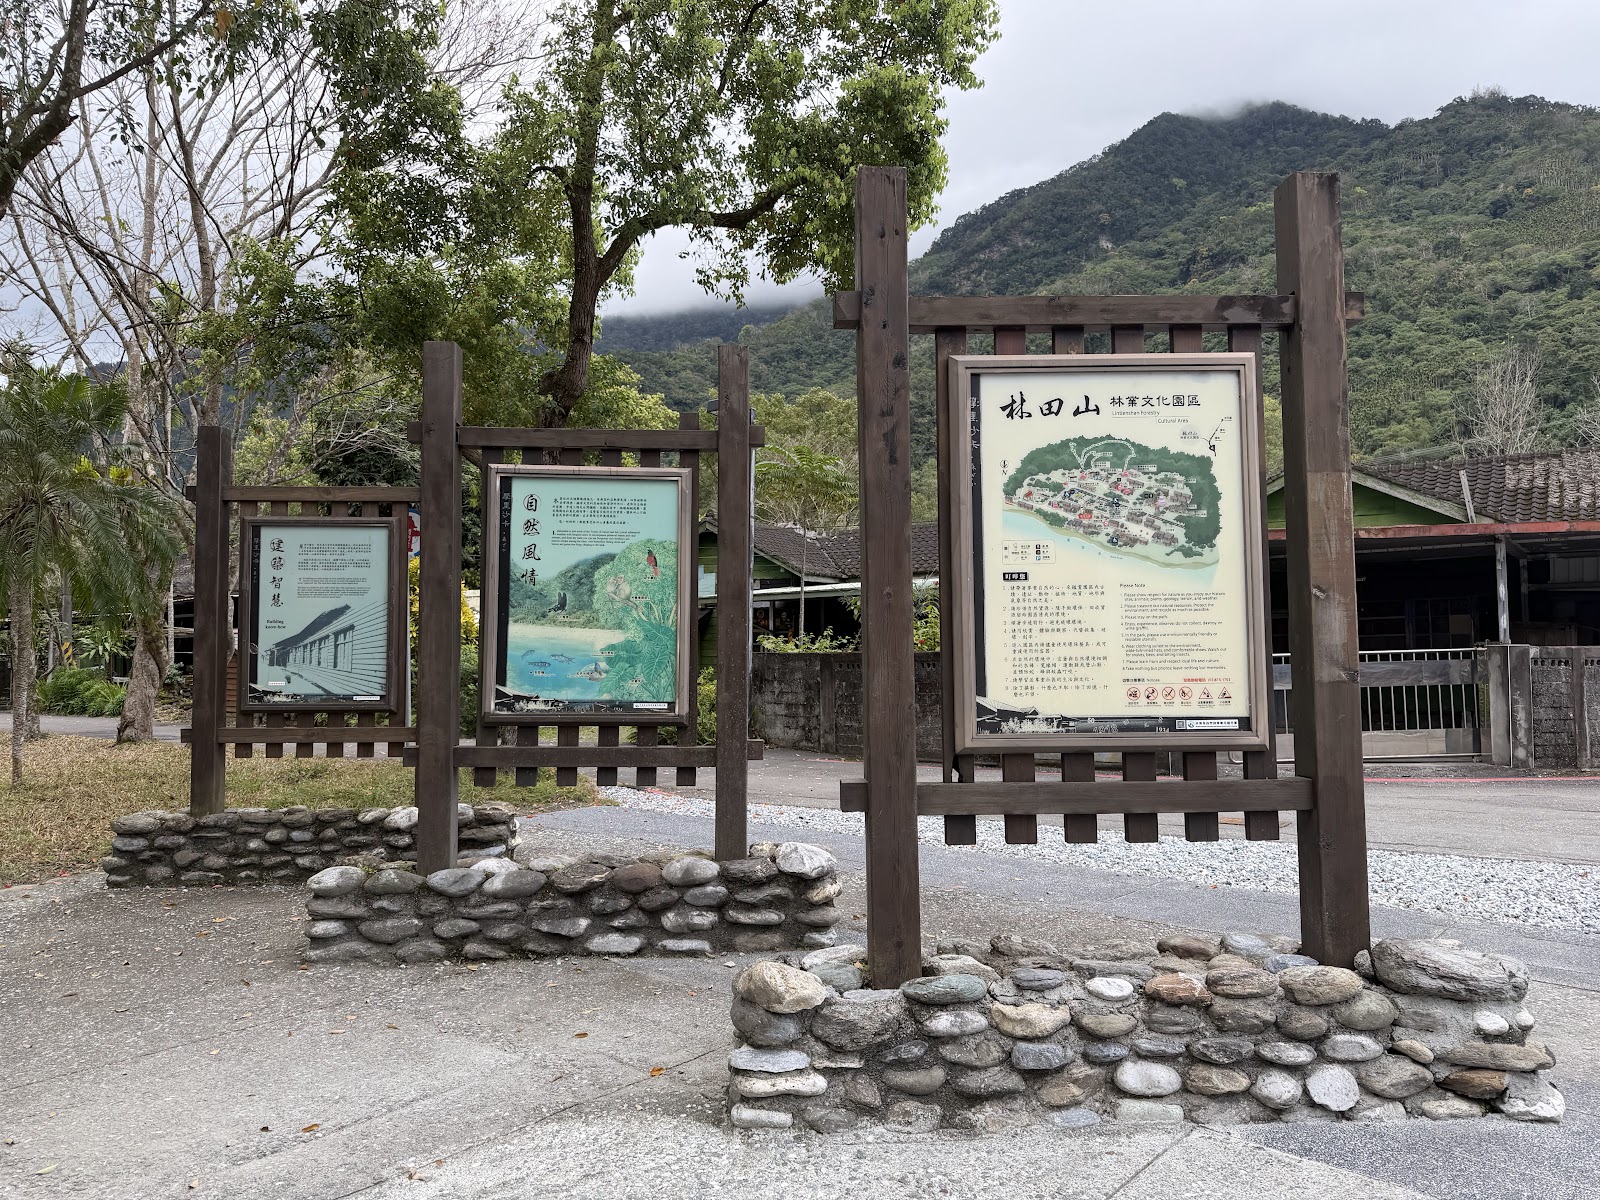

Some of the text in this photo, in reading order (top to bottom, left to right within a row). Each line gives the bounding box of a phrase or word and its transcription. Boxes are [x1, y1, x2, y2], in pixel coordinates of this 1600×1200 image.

[999, 391, 1100, 420] 林田山
[1109, 394, 1201, 408] 林業文化園區
[520, 494, 541, 586] 自然風情
[270, 538, 285, 608] 建築智慧
